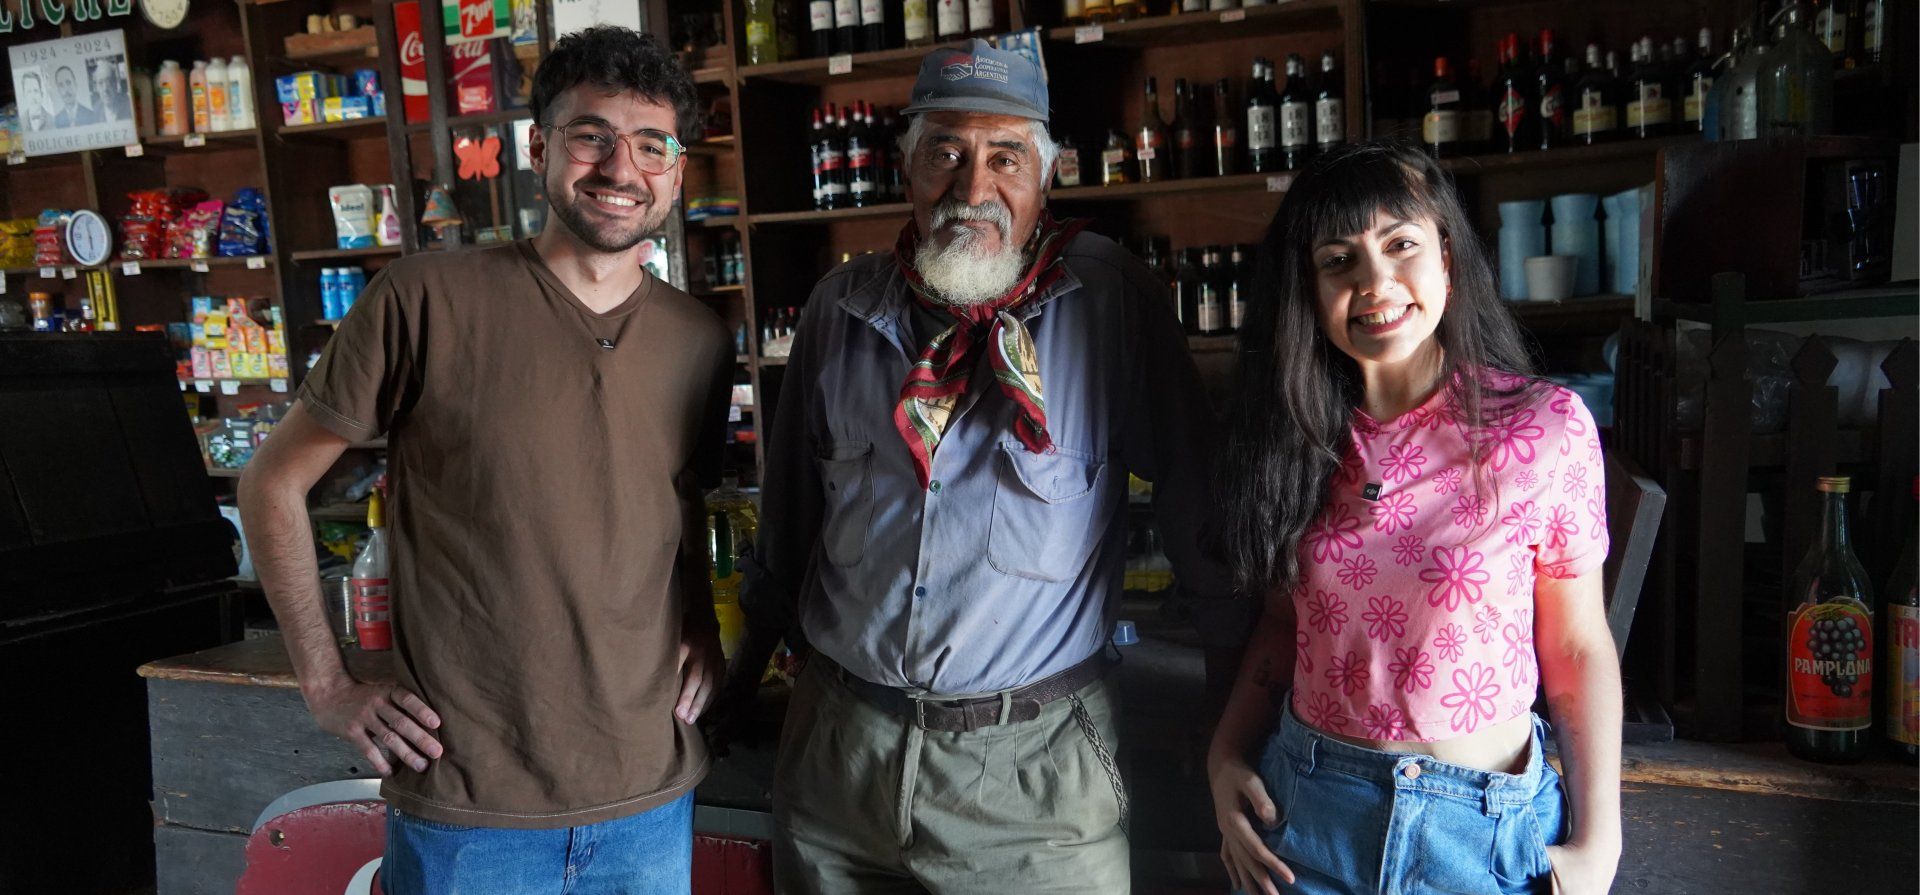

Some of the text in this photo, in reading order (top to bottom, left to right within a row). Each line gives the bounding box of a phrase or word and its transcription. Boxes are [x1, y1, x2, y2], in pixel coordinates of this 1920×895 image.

[22, 46, 57, 63] 1924
[74, 38, 112, 55] 2024
[975, 69, 1008, 81] ARGENTINAS
[28, 134, 81, 152] BOLICHE
[1794, 657, 1871, 677] PAMPLONA
